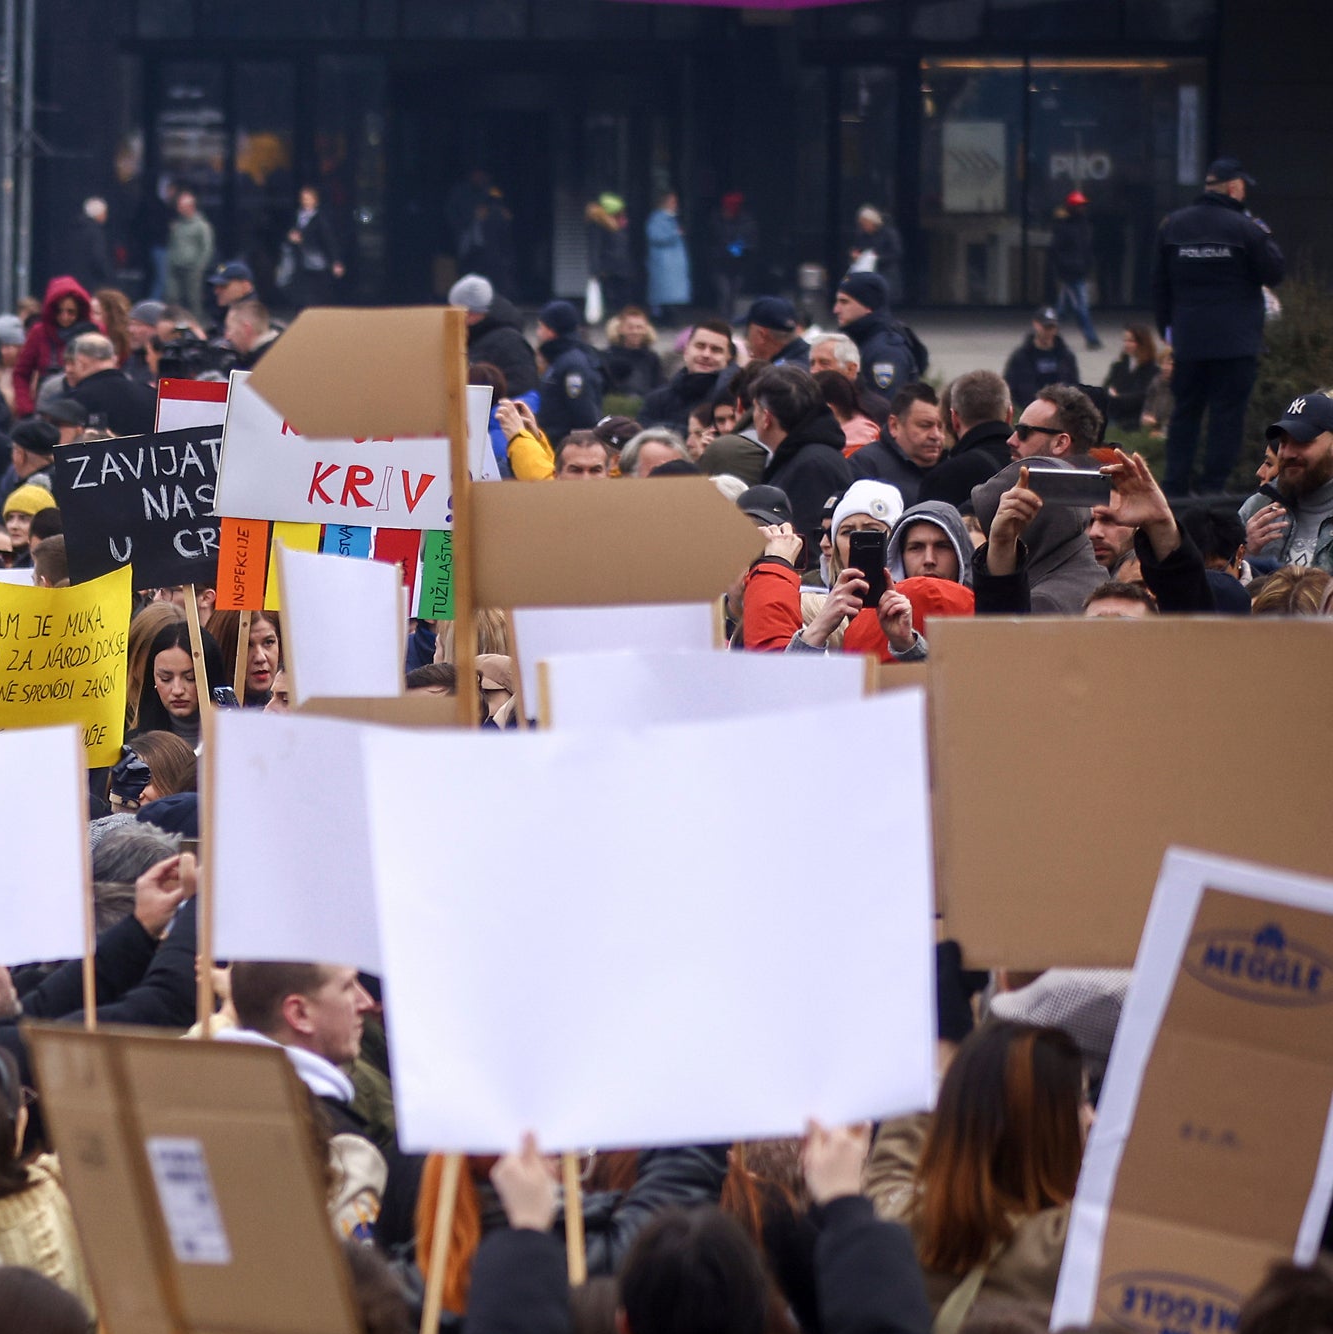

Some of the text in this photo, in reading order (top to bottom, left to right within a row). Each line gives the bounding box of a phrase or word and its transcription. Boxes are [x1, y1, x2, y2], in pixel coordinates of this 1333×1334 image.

[109, 536, 133, 563] U
[233, 527, 250, 606] INSPEKCIJE
[28, 615, 53, 638] JE
[61, 603, 105, 637] MUKA
[6, 650, 34, 671] ZA
[19, 679, 75, 704] SPROVODI
[82, 664, 119, 698] ZAKON
[1203, 943, 1323, 992] MEGGLE
